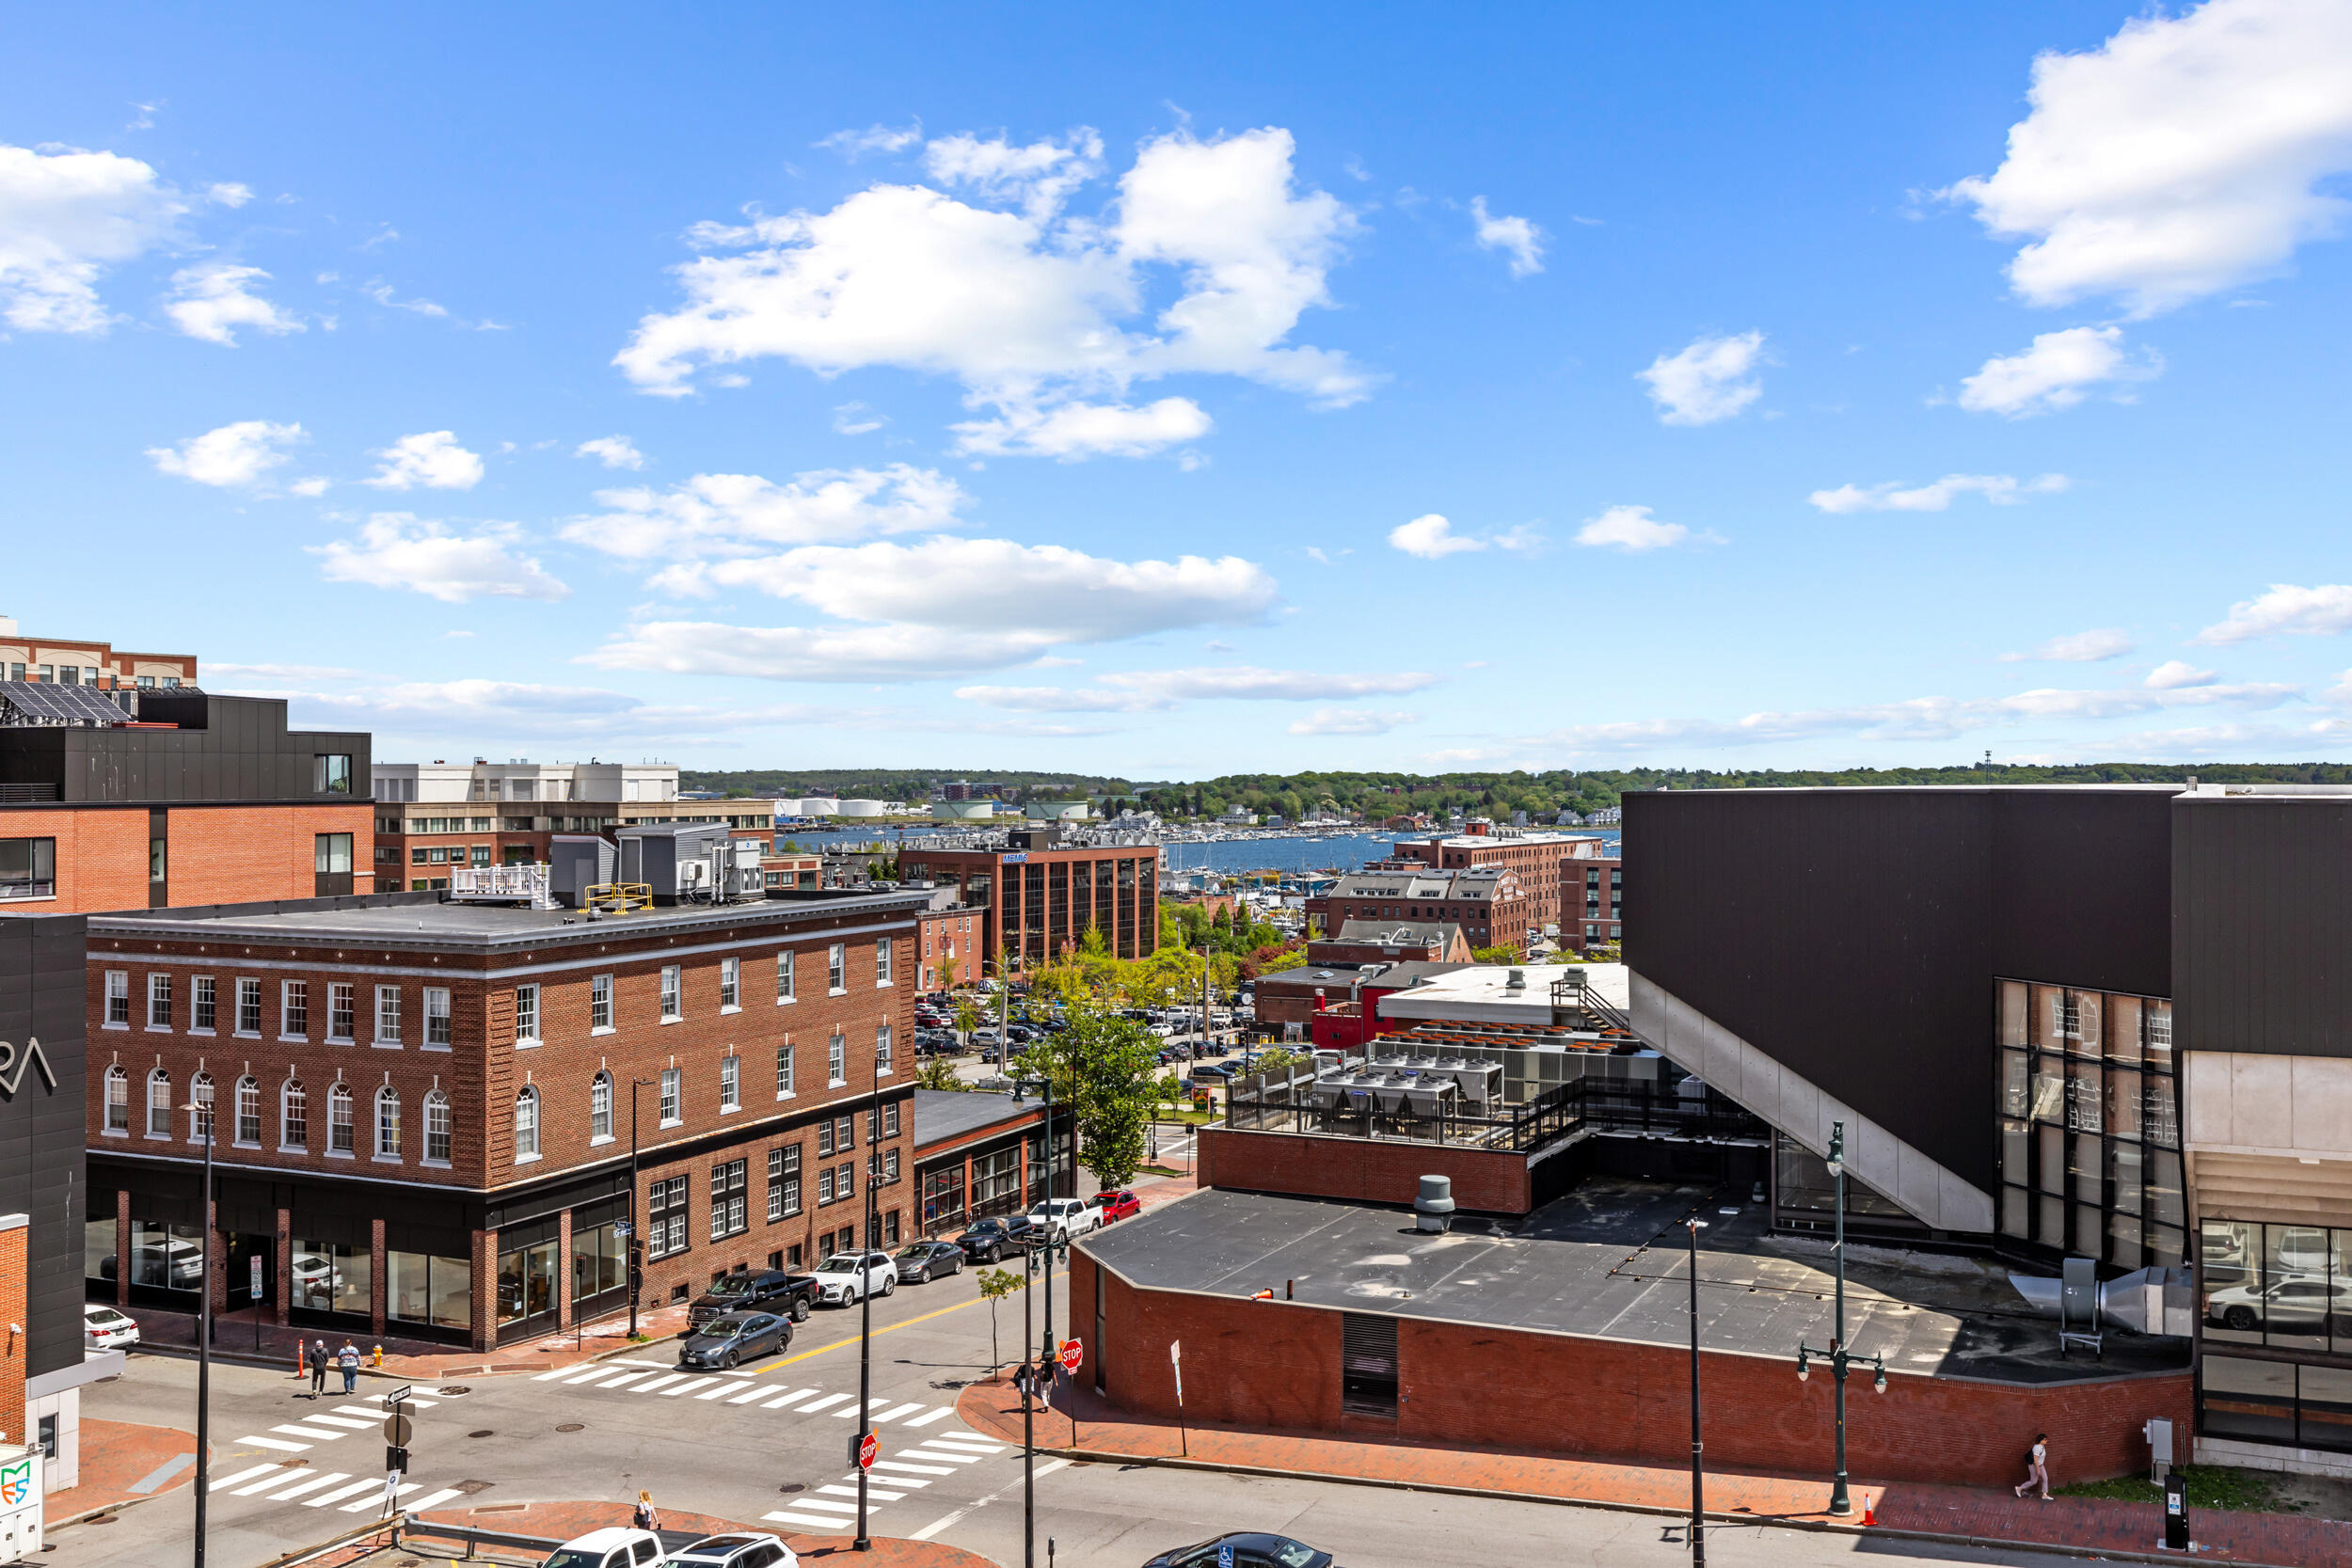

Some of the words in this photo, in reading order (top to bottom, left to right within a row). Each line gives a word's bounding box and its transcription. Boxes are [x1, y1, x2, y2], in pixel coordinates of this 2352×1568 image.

[1003, 852, 1028, 863] MEMIC
[1063, 1347, 1081, 1362] STOP
[861, 1442, 876, 1461] STOP
